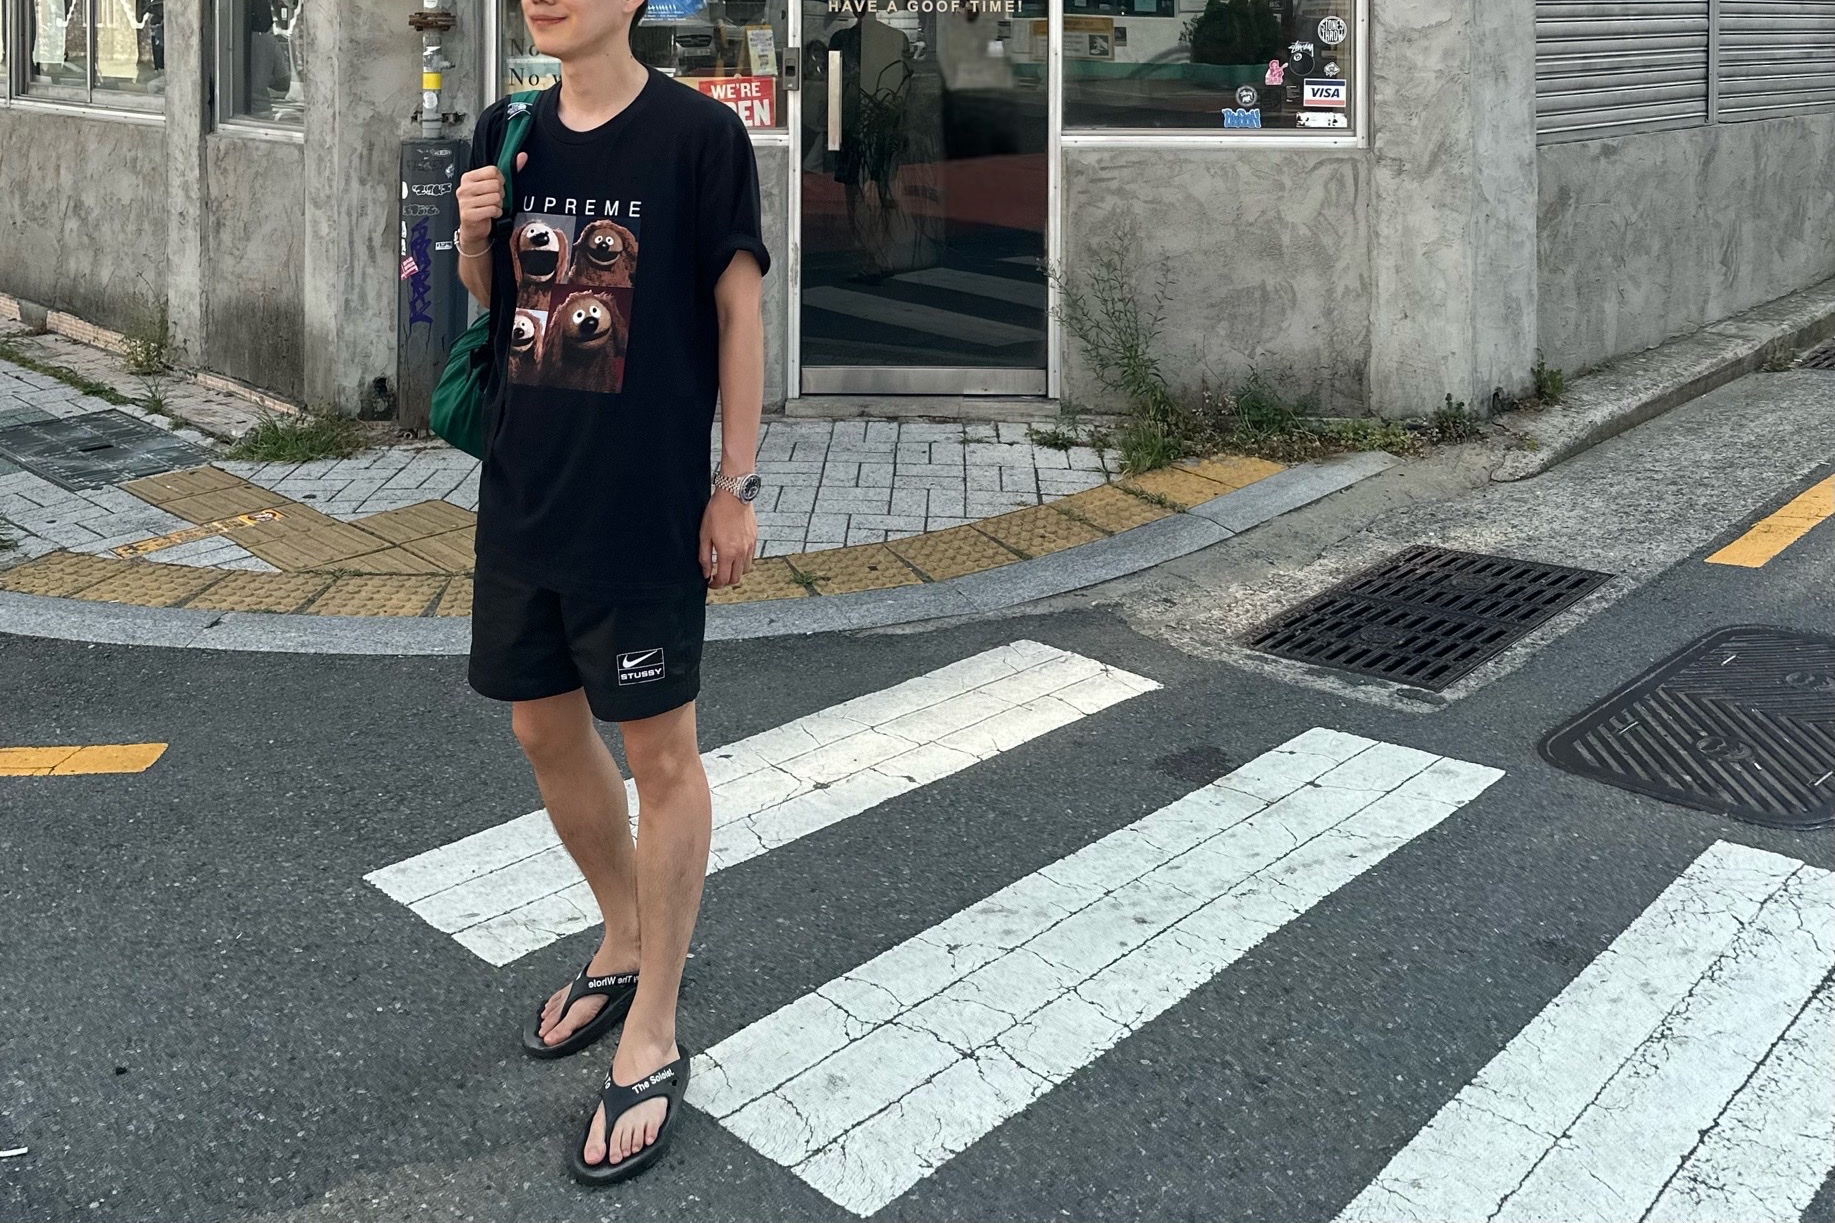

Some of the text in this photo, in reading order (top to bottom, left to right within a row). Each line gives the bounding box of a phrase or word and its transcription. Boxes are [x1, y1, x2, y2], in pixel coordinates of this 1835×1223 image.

[828, 0, 1023, 13] HAVE A GOOF TIME!
[509, 67, 540, 86] No
[1311, 88, 1340, 98] VISA
[523, 195, 642, 217] UPREME
[620, 668, 662, 680] STUSSY
[631, 1081, 650, 1094] The
